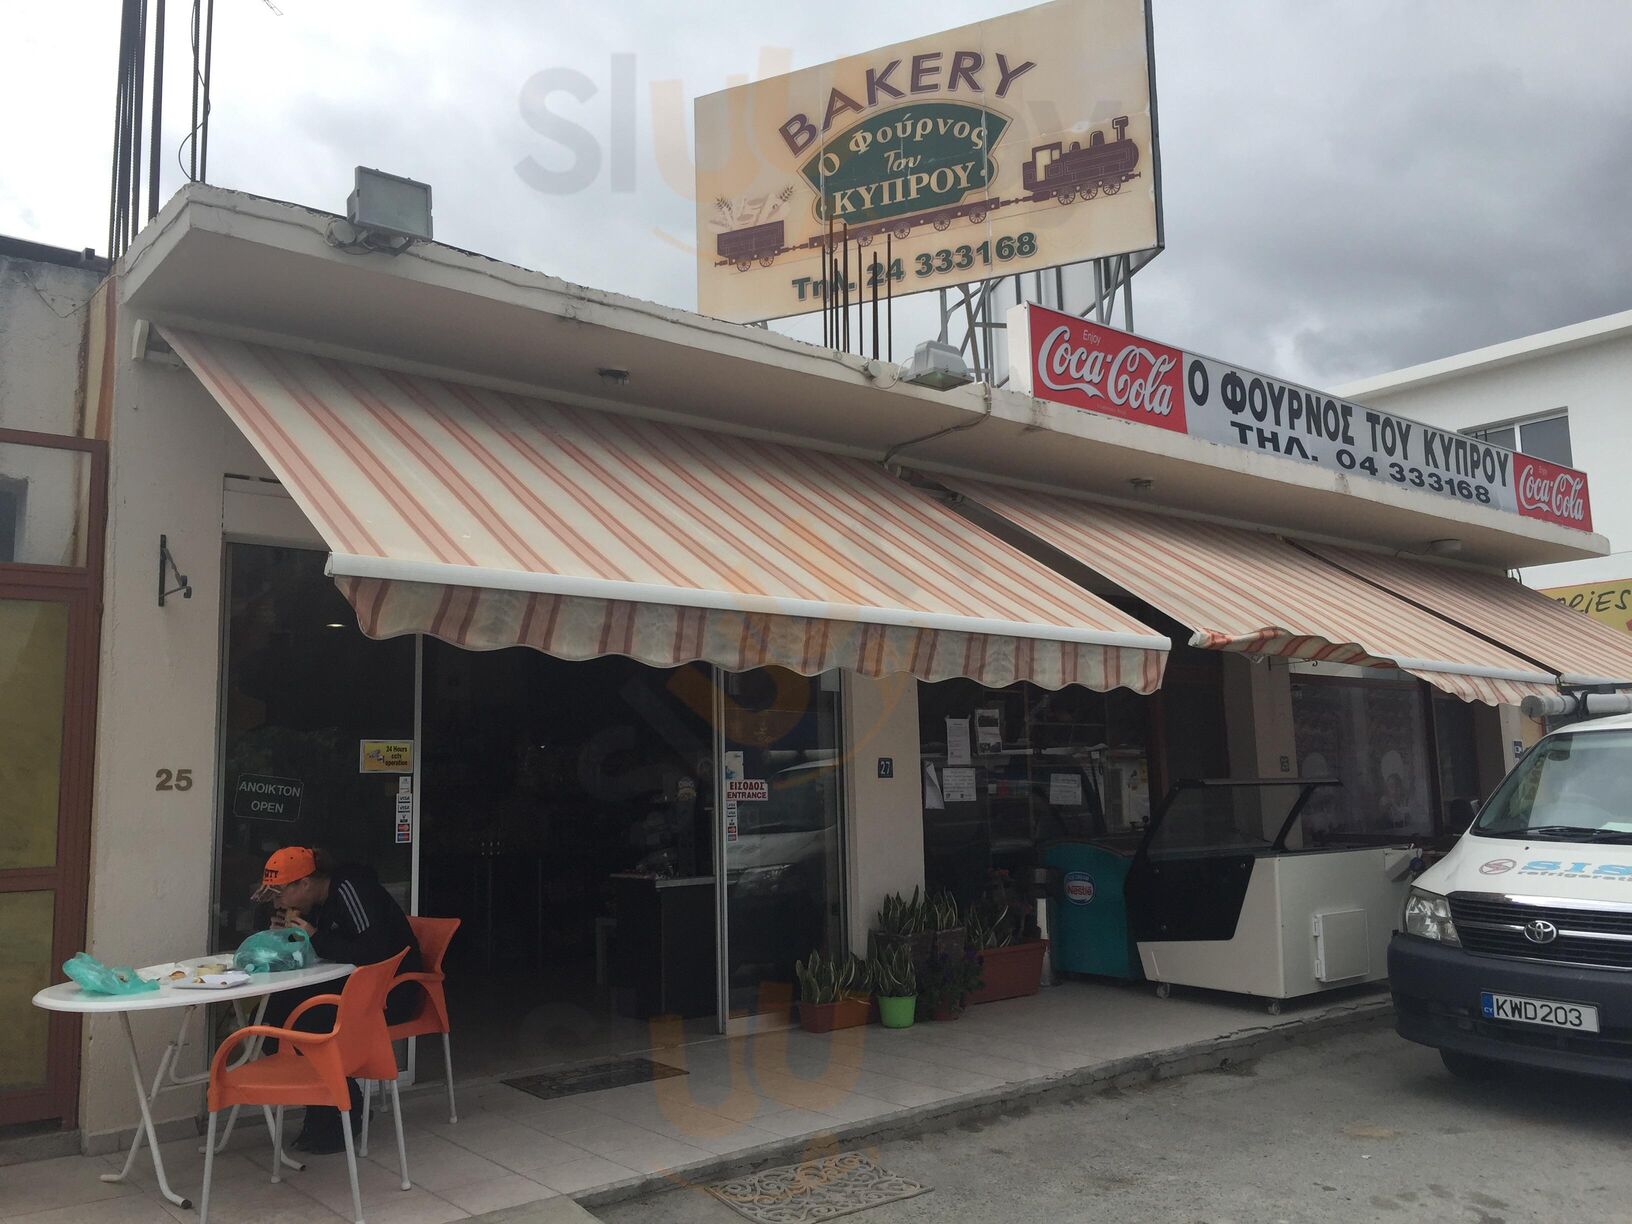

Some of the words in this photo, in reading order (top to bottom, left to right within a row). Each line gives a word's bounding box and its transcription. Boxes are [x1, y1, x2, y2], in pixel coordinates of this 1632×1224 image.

[779, 51, 1038, 158] BAKERY
[849, 113, 988, 155] Φούρνος
[884, 150, 922, 174] Του
[832, 161, 976, 216] ΚΥΠΡΟΥ
[866, 258, 906, 288] 24
[914, 231, 1038, 279] 333168
[1083, 329, 1102, 344] Enjoy
[1188, 359, 1210, 407] Ο
[1221, 371, 1355, 446] ΦΟΥΡΝΟΣ
[1366, 411, 1412, 461] ΤΟΥ
[1423, 429, 1510, 487] ΚΥΠΡΟΥ
[1230, 420, 1319, 462] ΤΗΛ.
[1336, 449, 1378, 477] 04
[1389, 462, 1491, 504] 333168
[155, 768, 193, 792] 25
[880, 761, 891, 776] 27
[727, 791, 767, 799] ENTRANCE
[729, 781, 765, 791] ΕΙΣΟΔΟΣ
[251, 800, 285, 814] OPEN
[1495, 997, 1583, 1027] KWD203
